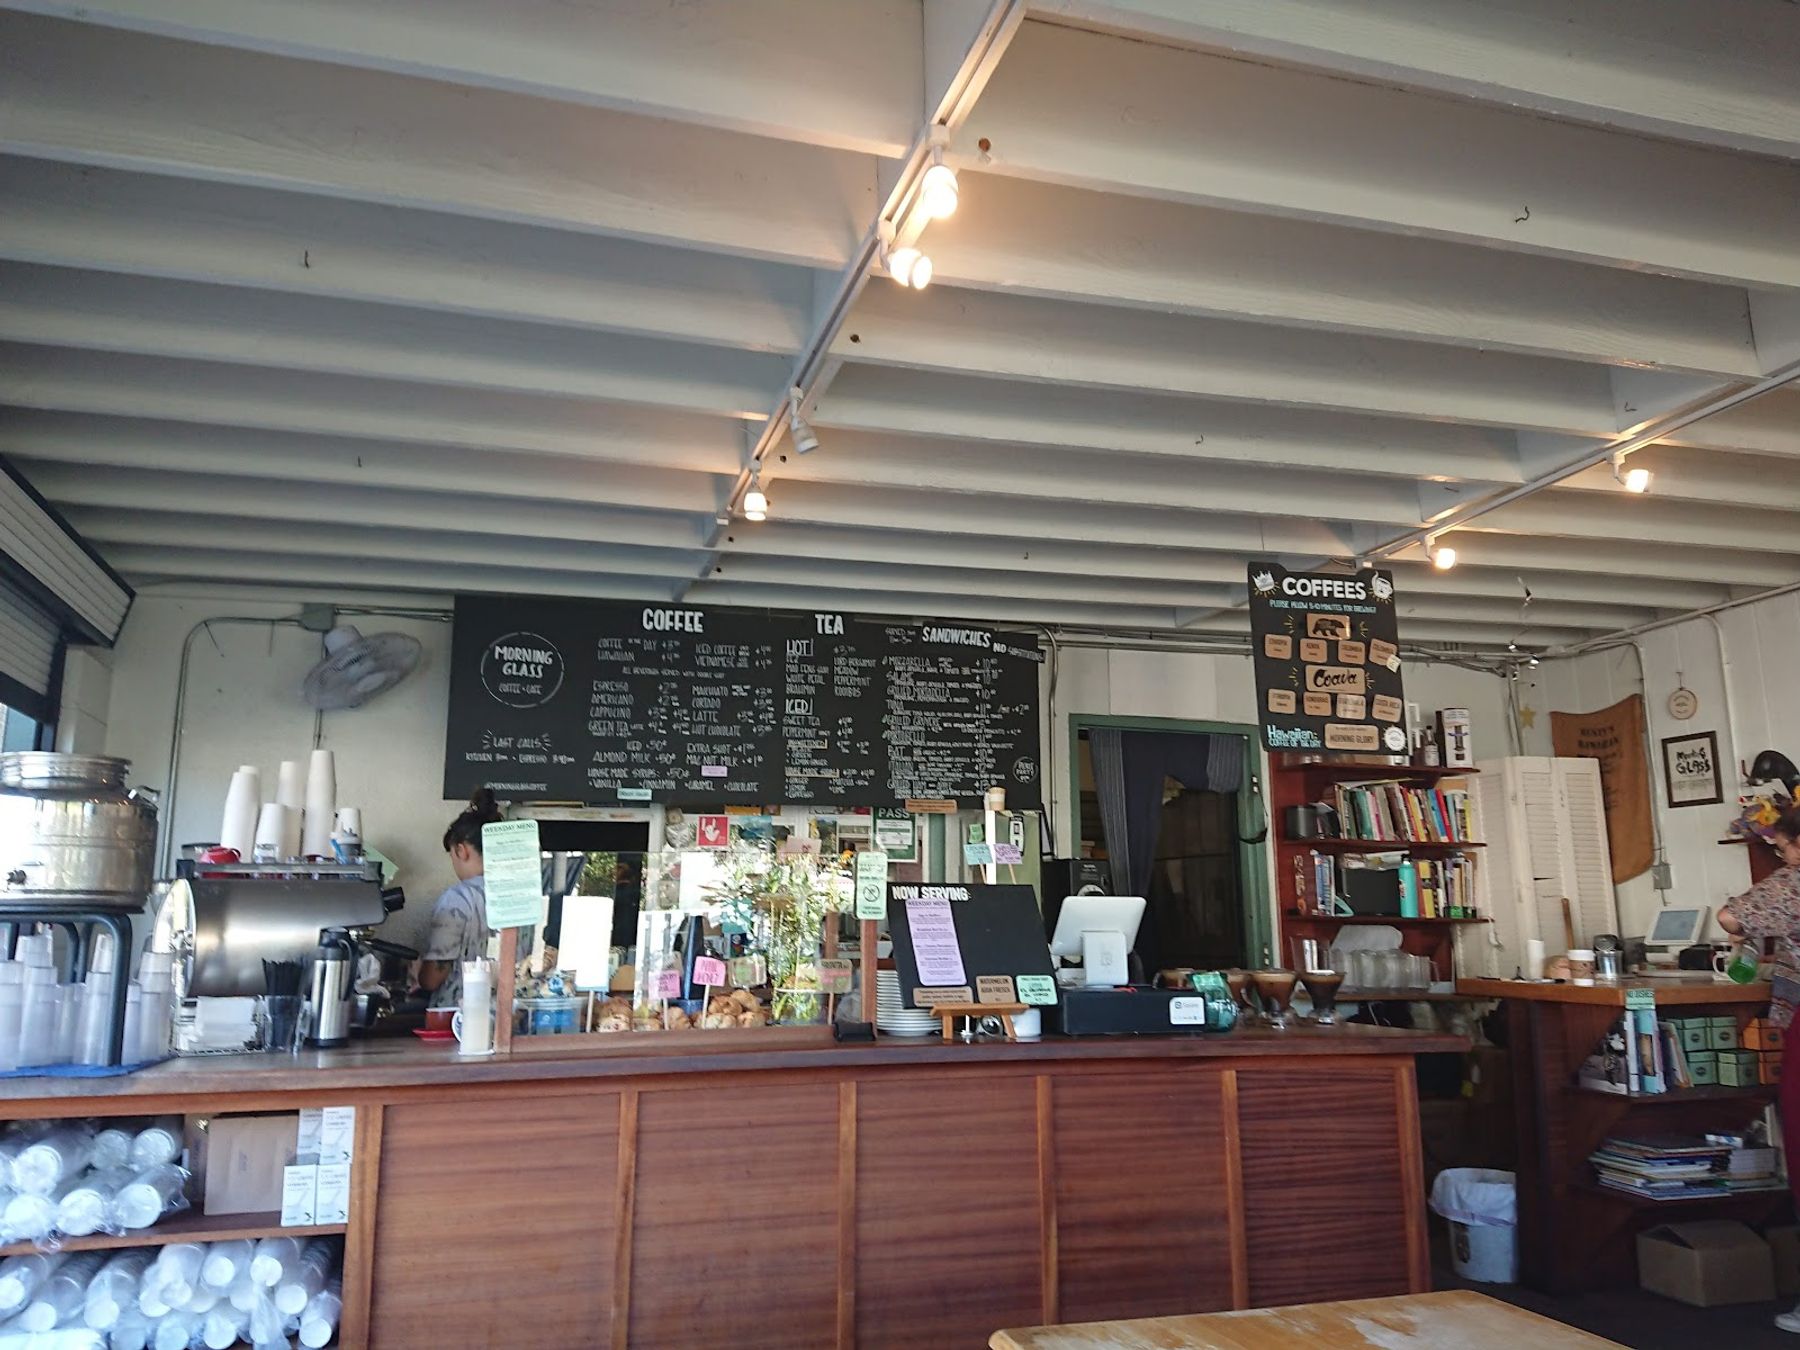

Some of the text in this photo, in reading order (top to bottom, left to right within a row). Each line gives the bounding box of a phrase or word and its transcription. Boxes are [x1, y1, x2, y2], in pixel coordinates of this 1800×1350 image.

[1282, 577, 1367, 600] COFFEES
[642, 608, 704, 633] COFFEE
[814, 613, 844, 635] TEA
[922, 626, 992, 648] SANDWICHES
[494, 645, 554, 665] MORNING
[786, 639, 809, 656] HOT
[993, 642, 1007, 653] NO
[502, 662, 543, 679] GLASS
[1313, 669, 1359, 687] Coava
[786, 699, 809, 714] ICED
[693, 711, 718, 723] LATTE
[493, 737, 514, 748] LAST
[592, 751, 627, 763] ALMOND
[631, 752, 651, 763] MILK
[1675, 760, 1711, 775] GLASS
[879, 807, 910, 818] PASS
[891, 885, 919, 900] NOW
